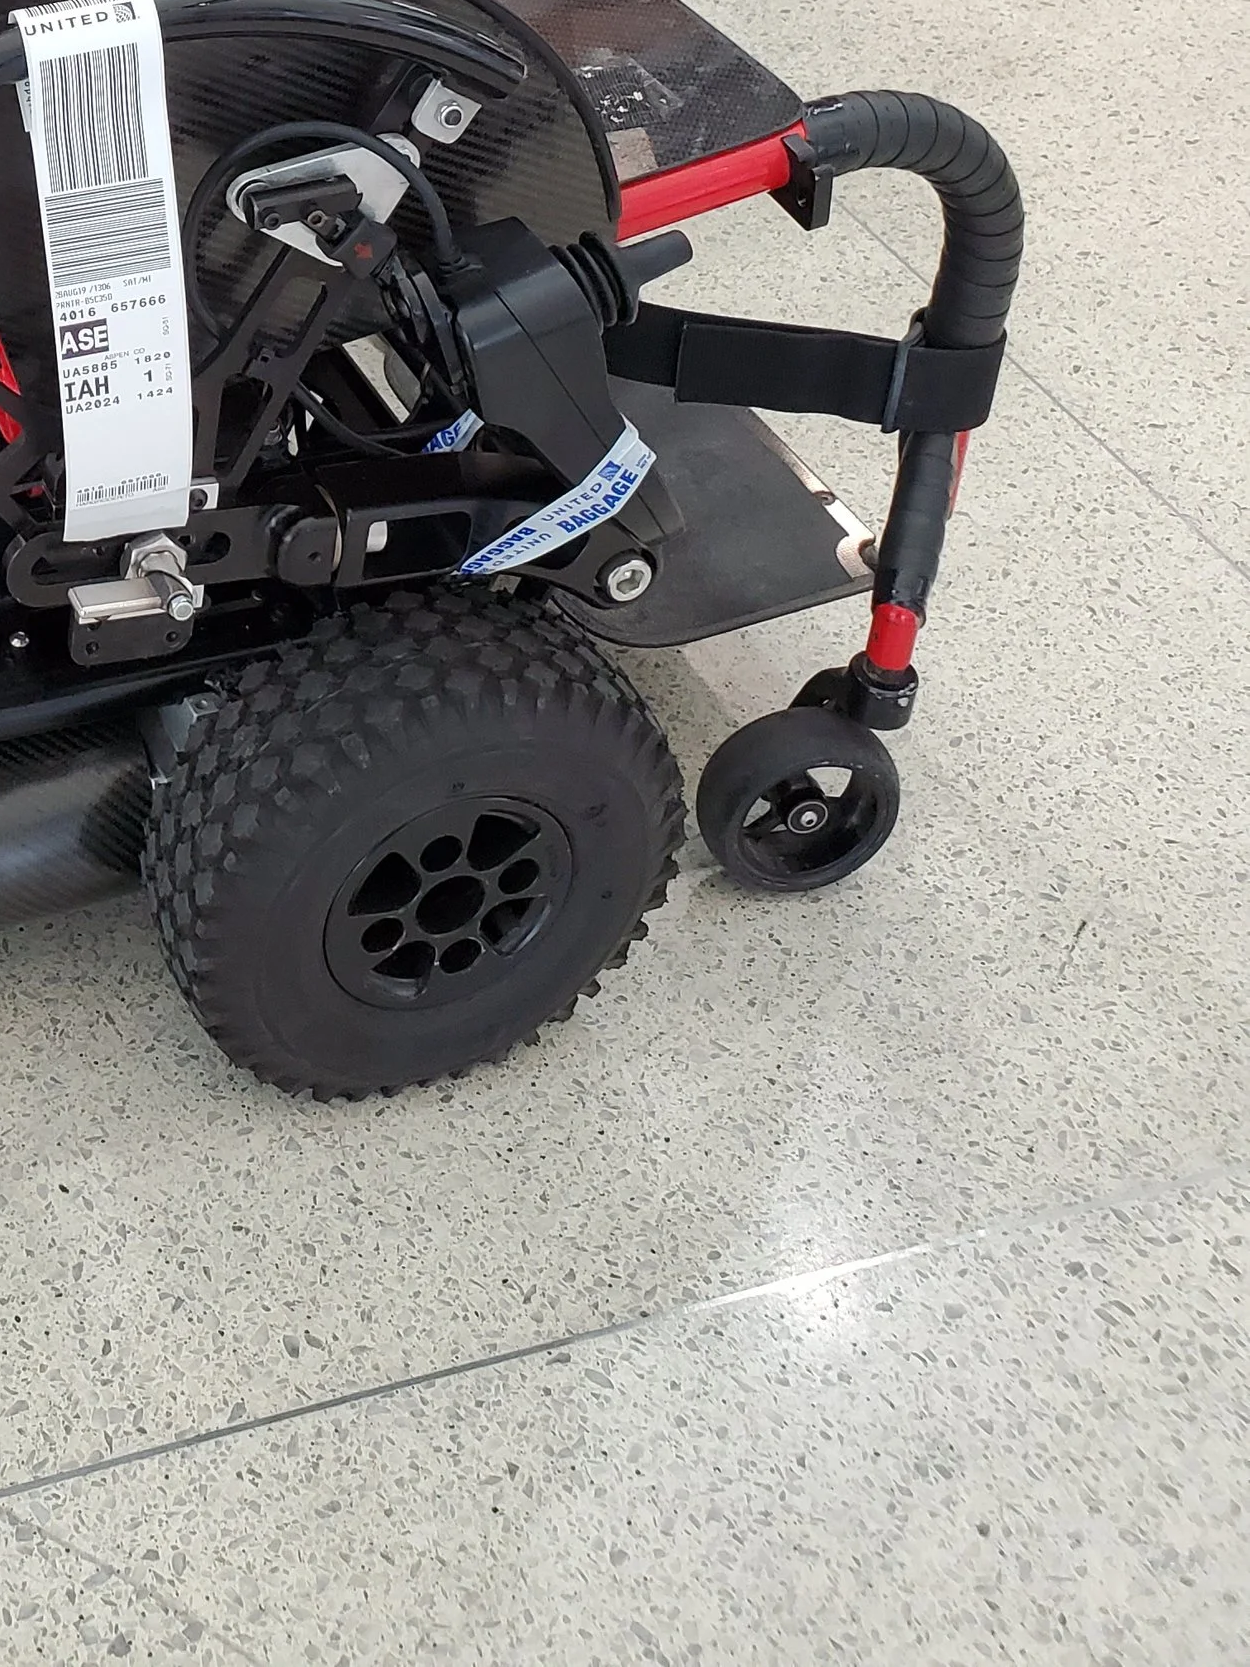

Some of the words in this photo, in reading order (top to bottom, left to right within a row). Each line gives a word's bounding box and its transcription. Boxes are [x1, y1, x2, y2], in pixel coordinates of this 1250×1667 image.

[24, 11, 108, 36] UNITED
[59, 307, 96, 322] 4016
[110, 294, 166, 313] 657666
[61, 324, 110, 355] ASE
[62, 359, 118, 379] UA5885
[134, 351, 171, 365] 1820
[64, 375, 110, 403] IAH
[143, 369, 152, 382] 1
[65, 395, 120, 415] UA2024
[137, 386, 173, 400] 1424
[541, 483, 602, 521] UNITED
[556, 469, 639, 533] BAGGAGE
[492, 533, 552, 566] UNITED
